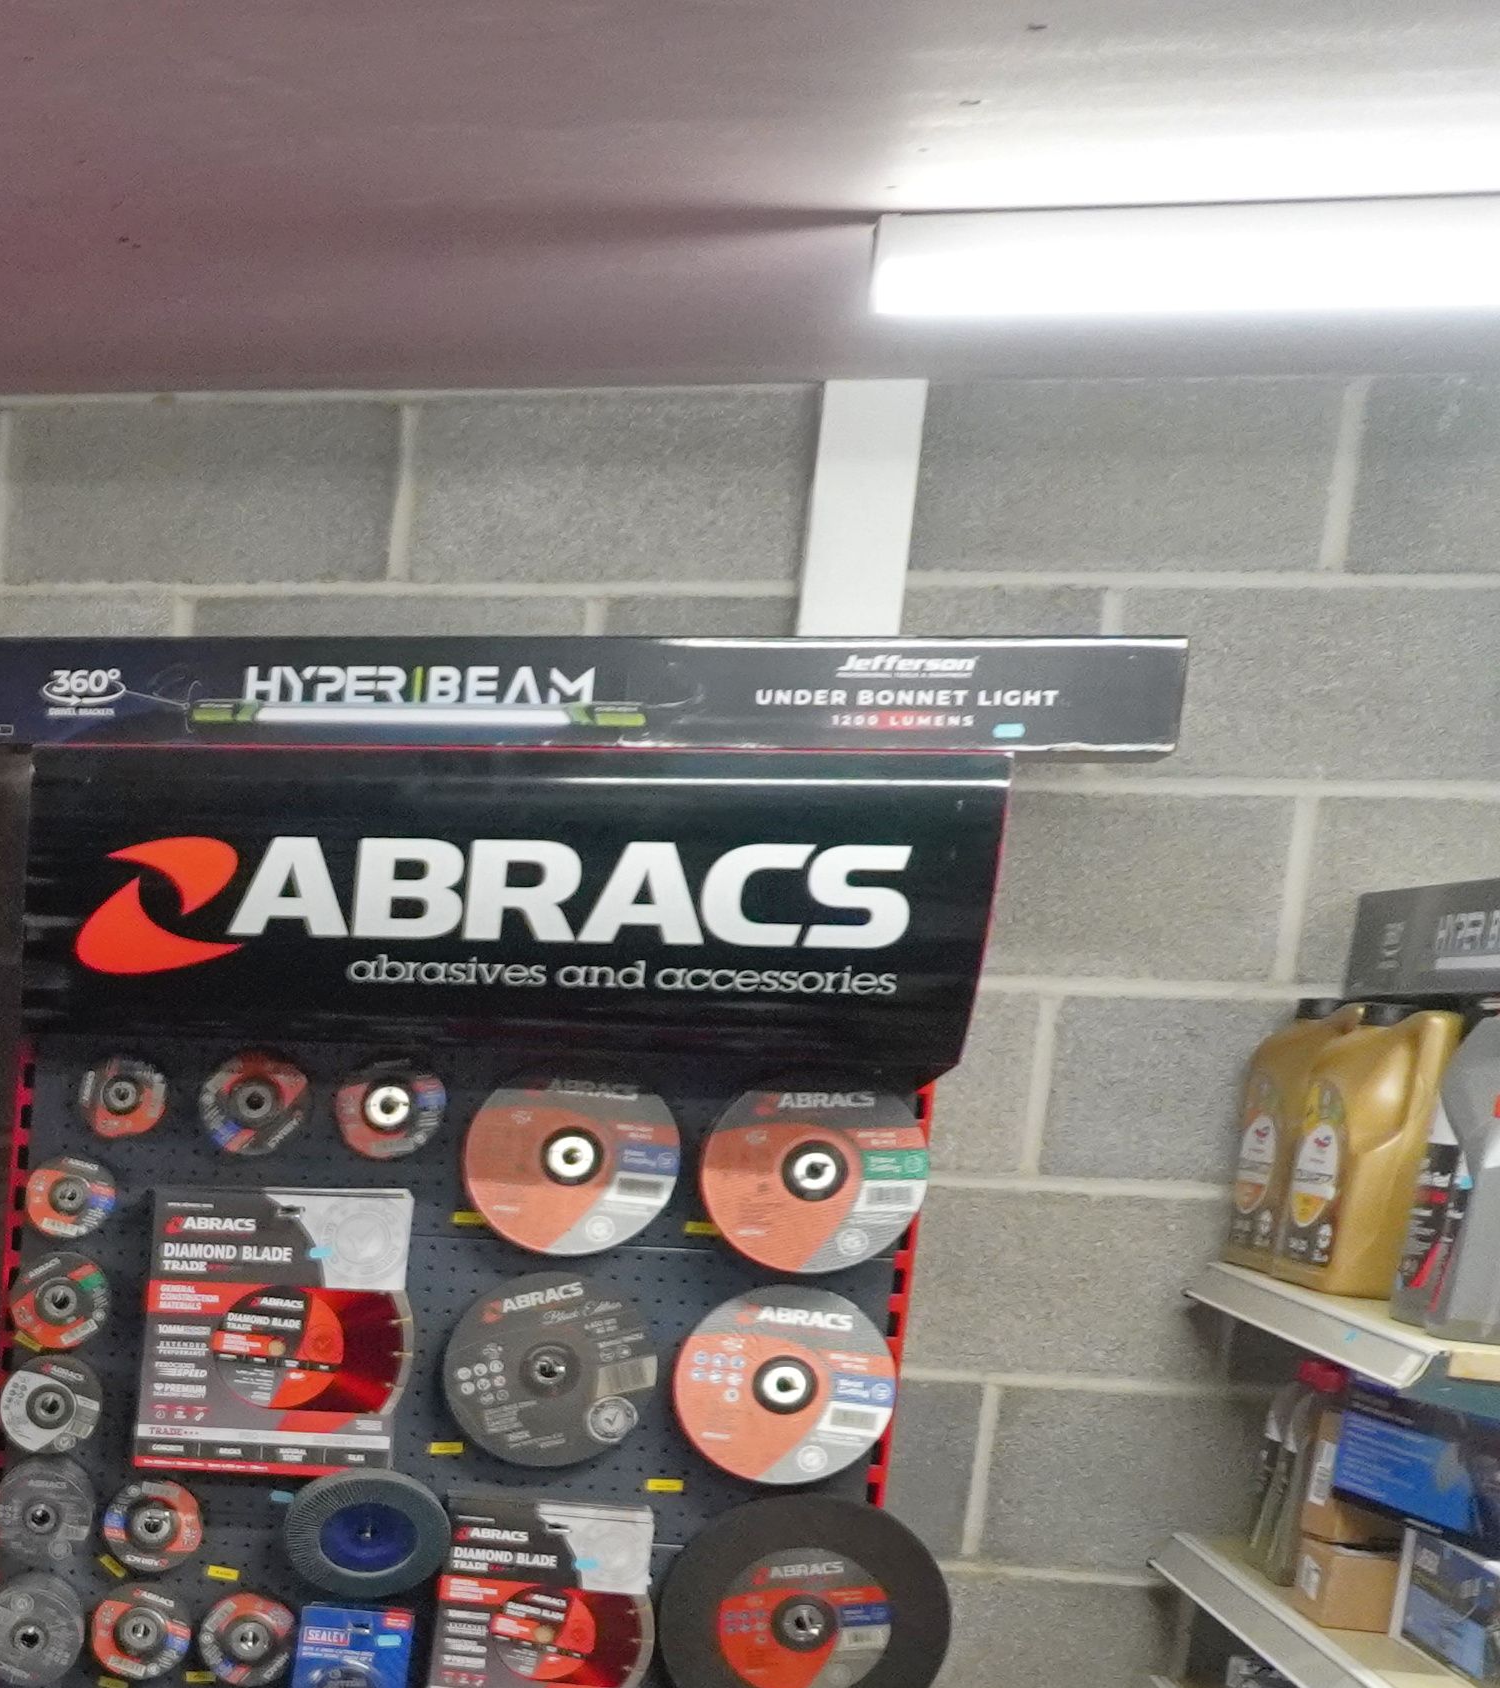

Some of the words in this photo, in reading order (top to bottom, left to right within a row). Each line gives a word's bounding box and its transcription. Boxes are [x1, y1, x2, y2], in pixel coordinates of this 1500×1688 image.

[836, 655, 980, 672] Jefferson
[755, 689, 847, 706] UNDER
[856, 690, 968, 706] BONNET
[977, 690, 1059, 706] LIGHT
[832, 714, 879, 726] 1200
[889, 714, 975, 727] LUMENS
[227, 835, 914, 950] ABRACS
[347, 953, 548, 988] abrasives
[556, 956, 646, 991] and
[655, 963, 899, 998] accessories
[778, 1092, 875, 1108] ABRACS
[183, 1217, 257, 1231] ABRACS
[163, 1243, 238, 1260] DIAMOND
[242, 1245, 293, 1262] BLADE
[163, 1260, 208, 1272] TRADE
[260, 1297, 304, 1309] ABRACS
[502, 1282, 584, 1314] ABRACS
[227, 1312, 270, 1325] DIAMOND
[272, 1315, 302, 1329] BLADE
[757, 1306, 854, 1331] ABRACS
[173, 1368, 208, 1378] SPEED
[164, 1384, 207, 1393] PREMIUM
[469, 1527, 529, 1542] ABRACS
[453, 1546, 512, 1565] DIAMOND
[516, 1551, 558, 1568] BLADE
[769, 1561, 844, 1577] ABRACS
[308, 1628, 348, 1643] SEALEY
